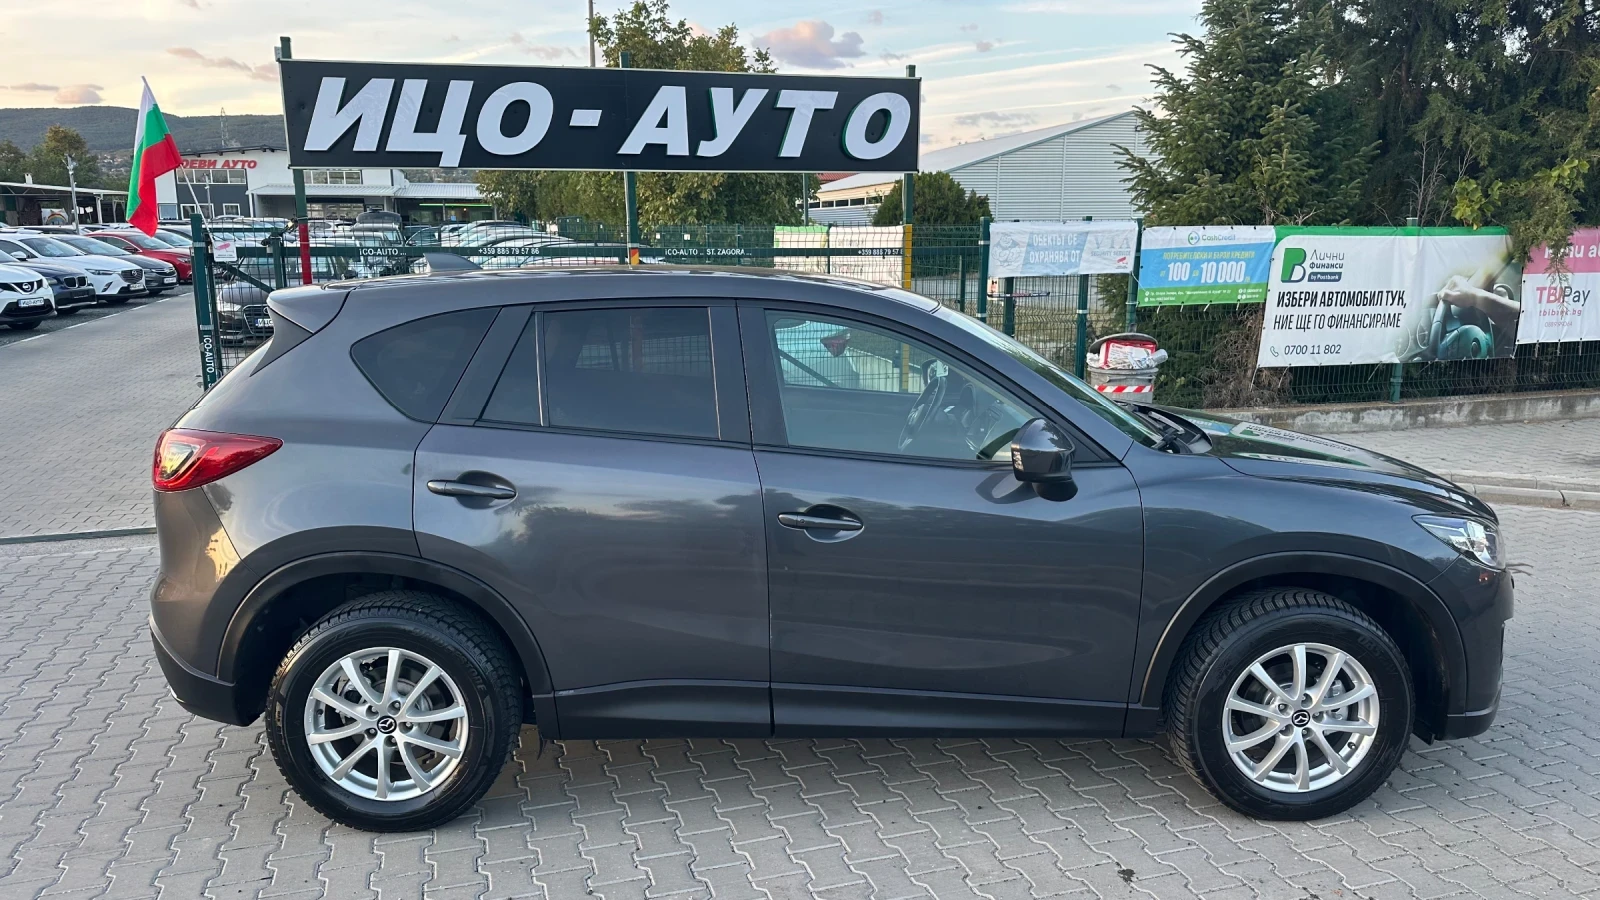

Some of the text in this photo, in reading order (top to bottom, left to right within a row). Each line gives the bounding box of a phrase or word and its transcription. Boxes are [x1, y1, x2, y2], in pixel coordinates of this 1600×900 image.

[304, 76, 554, 167] ИЦО
[617, 85, 911, 160] АУТО
[182, 159, 257, 169] ОЕВИ АУТО
[1032, 233, 1078, 247] ОБЕКТЪТ СЕ
[478, 247, 496, 255] +359
[511, 247, 520, 255] 79
[521, 247, 530, 255] 57
[717, 248, 745, 256] ZAGORA
[1029, 250, 1080, 264] ОХРАНЯВА ОТ
[1310, 249, 1344, 261] Лични
[1167, 262, 1191, 281] 100
[1277, 290, 1407, 308] ИЗБЕРИ АВТОМОБИЛ ТУК,
[1539, 308, 1582, 316] tbibk.bg
[1273, 313, 1402, 332] НИЕ ЩЕ ГО ФИНАНСИРАМЕ
[1284, 345, 1341, 355] 0700 11 802
